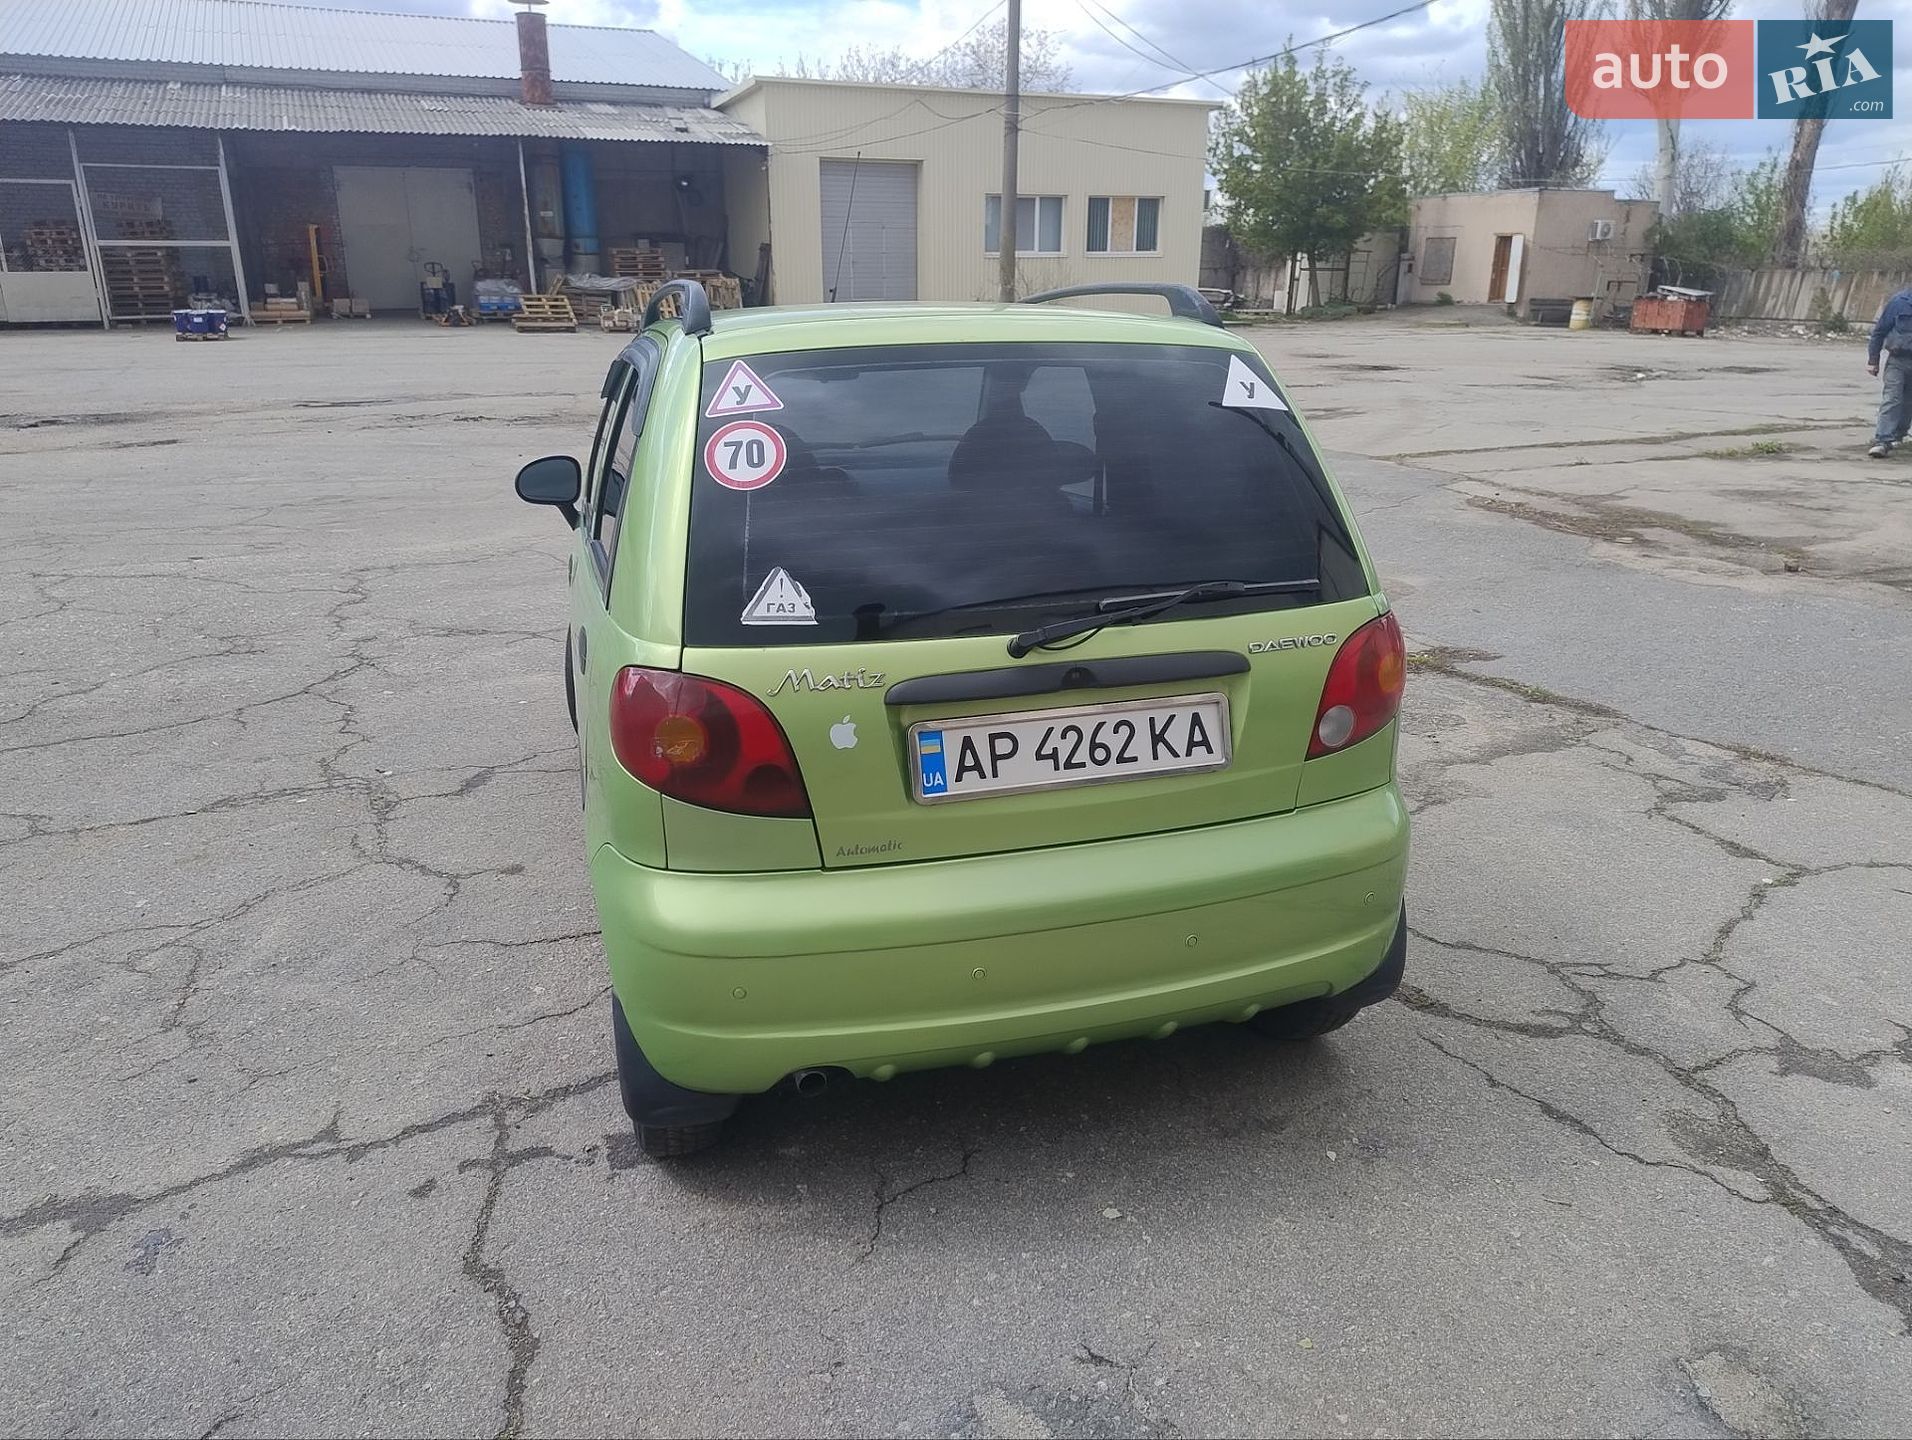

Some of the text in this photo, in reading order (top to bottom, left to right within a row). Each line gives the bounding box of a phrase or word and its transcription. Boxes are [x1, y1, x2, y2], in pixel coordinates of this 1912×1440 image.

[723, 438, 767, 470] 70
[766, 602, 796, 614] ГАЗ
[1248, 633, 1338, 654] DAEWOO
[766, 667, 886, 697] Matiz
[954, 711, 1215, 783] AP 4262 KA
[922, 772, 944, 788] UA
[836, 839, 903, 857] Automatic
